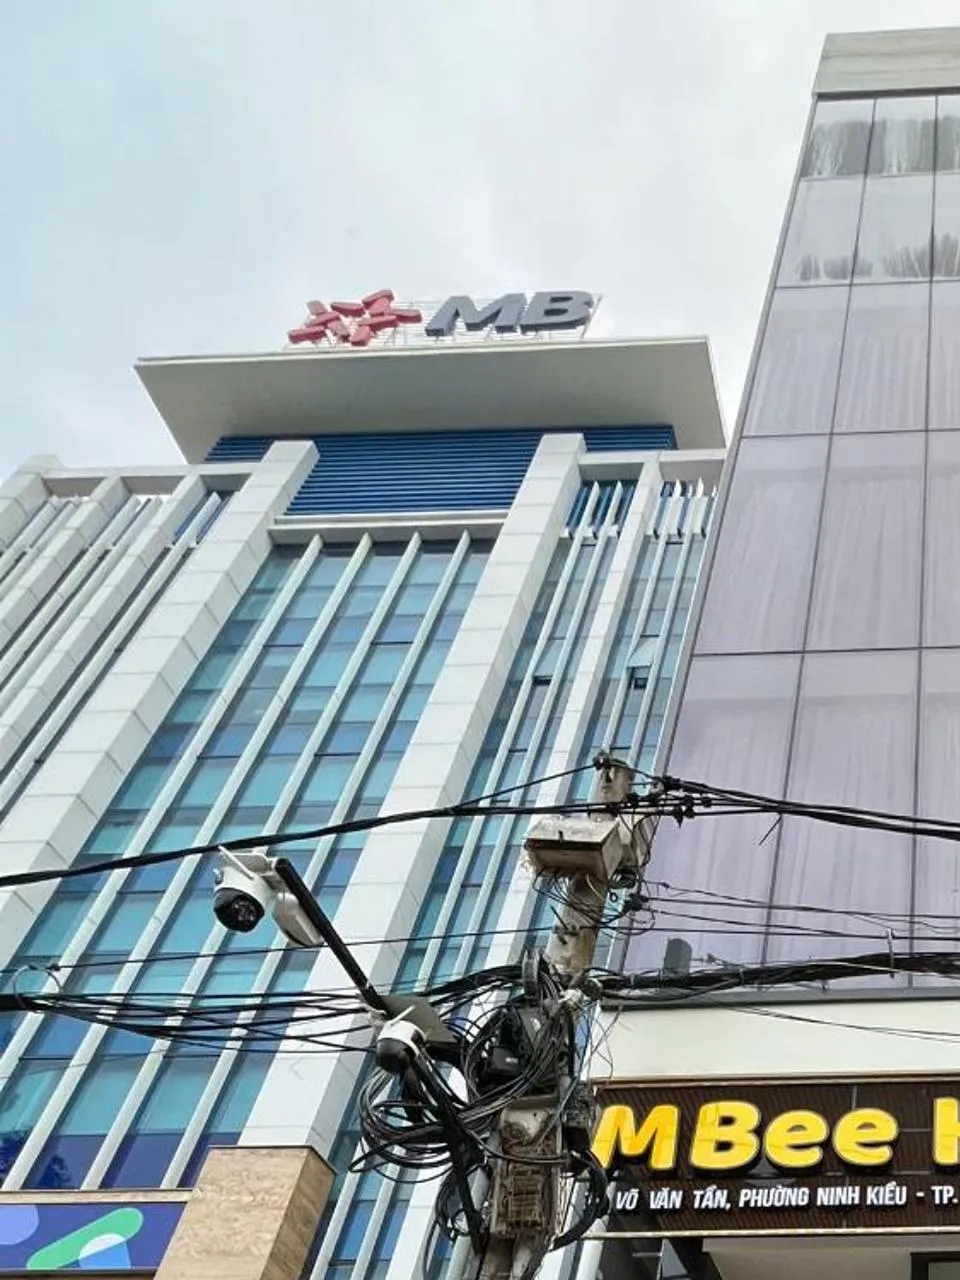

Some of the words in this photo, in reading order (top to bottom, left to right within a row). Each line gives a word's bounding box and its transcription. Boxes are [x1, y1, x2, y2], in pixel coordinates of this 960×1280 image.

[425, 290, 592, 337] MB
[738, 1184, 810, 1208] PHƯỜNG
[816, 1185, 861, 1206] NINH
[930, 1185, 958, 1205] TP.
